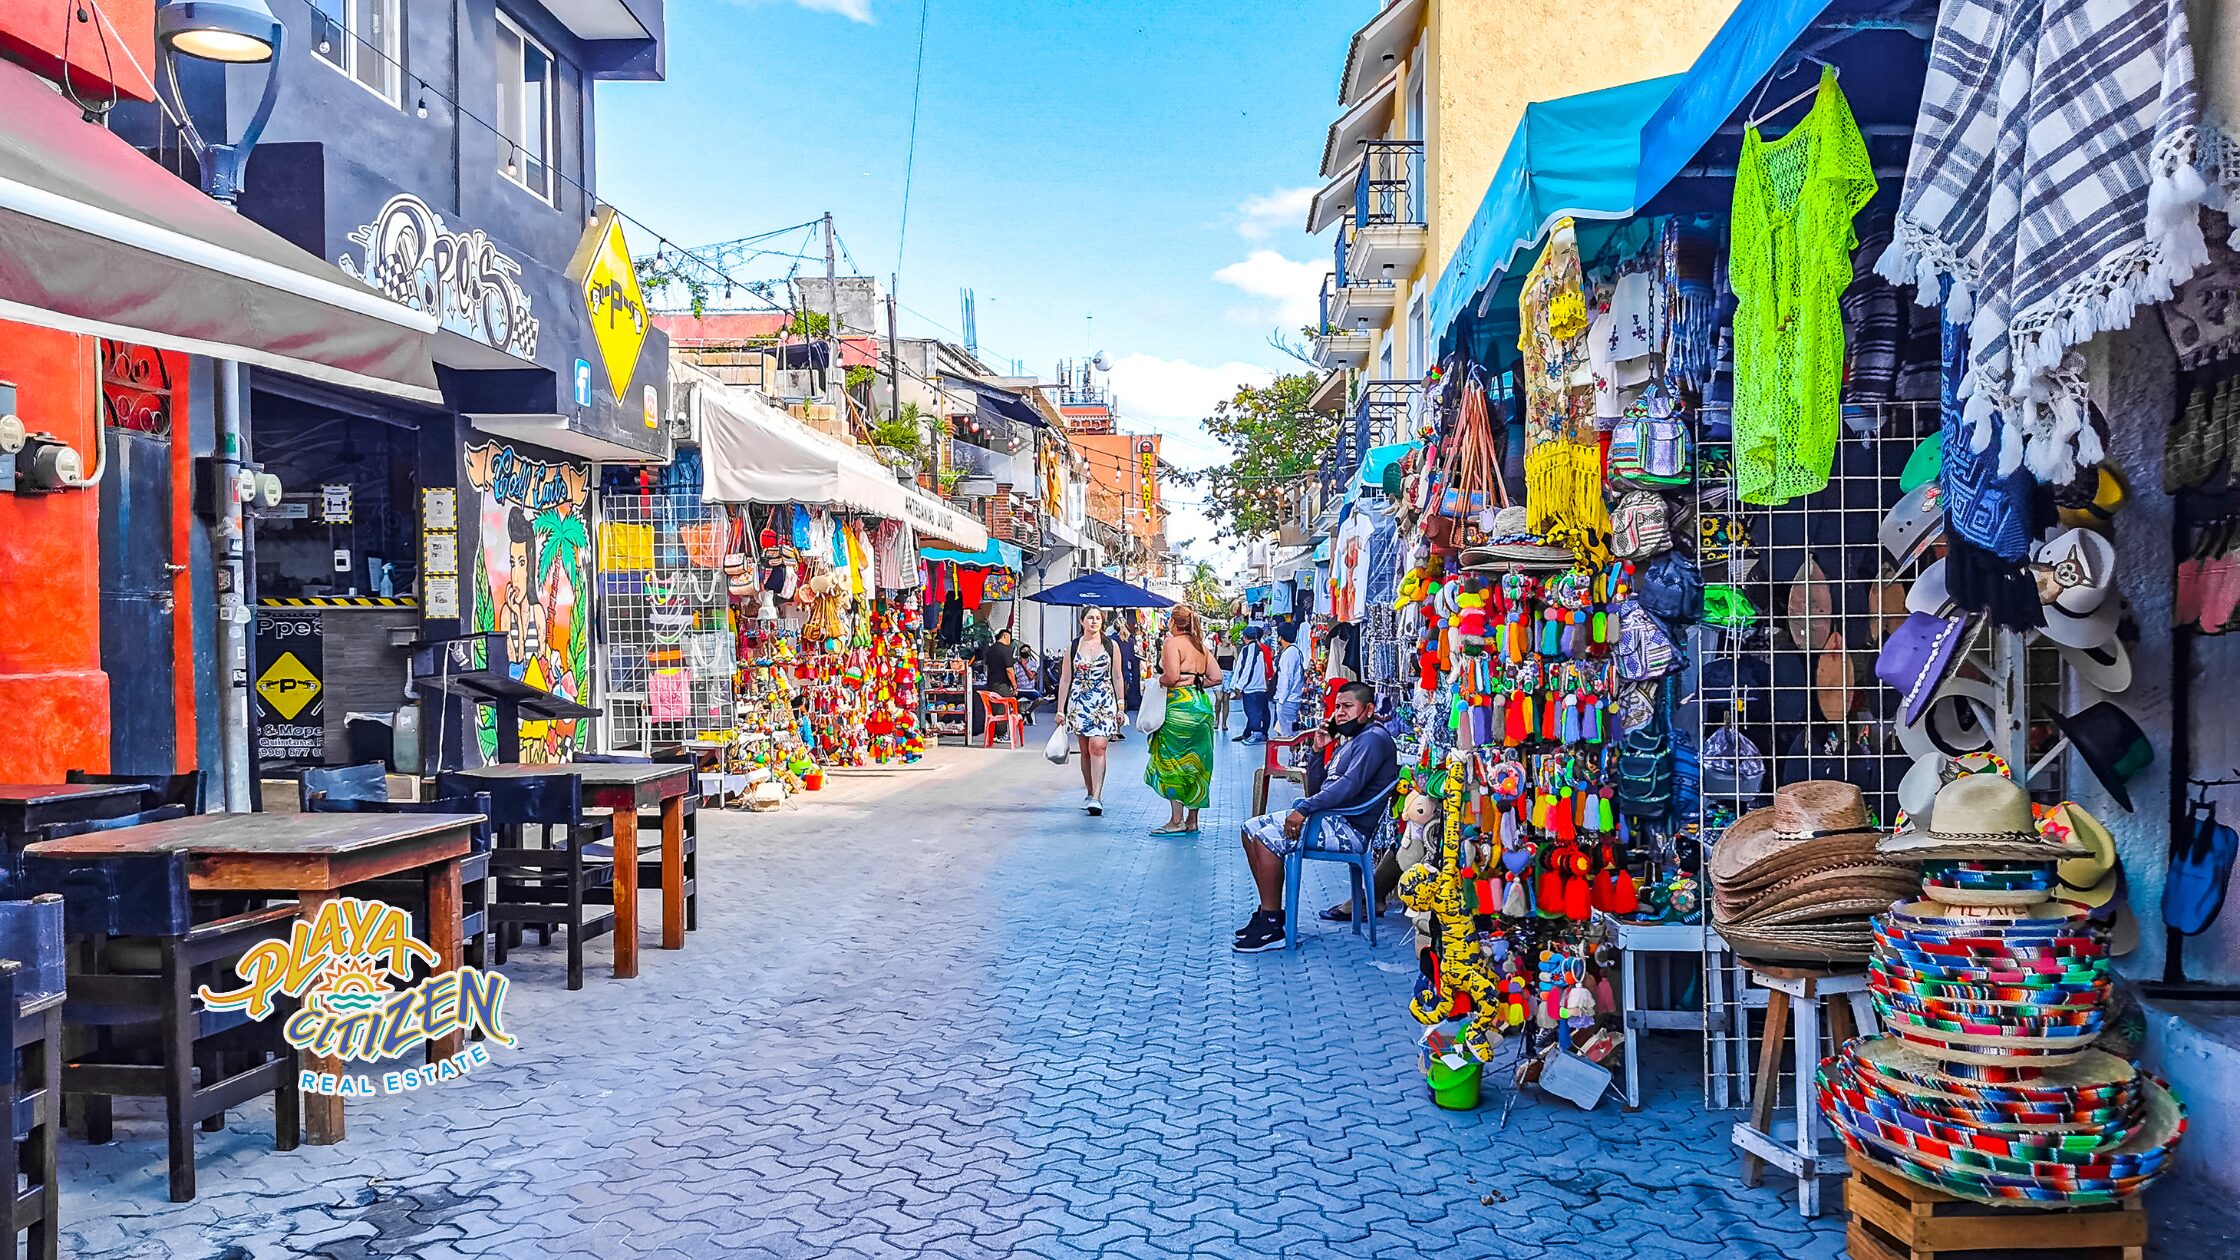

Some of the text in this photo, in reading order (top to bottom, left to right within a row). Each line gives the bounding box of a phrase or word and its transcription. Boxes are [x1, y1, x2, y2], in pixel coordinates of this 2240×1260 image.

[491, 447, 567, 509] Golf Carts
[279, 678, 297, 693] P
[259, 737, 315, 747] Quintana
[288, 747, 310, 758] 877
